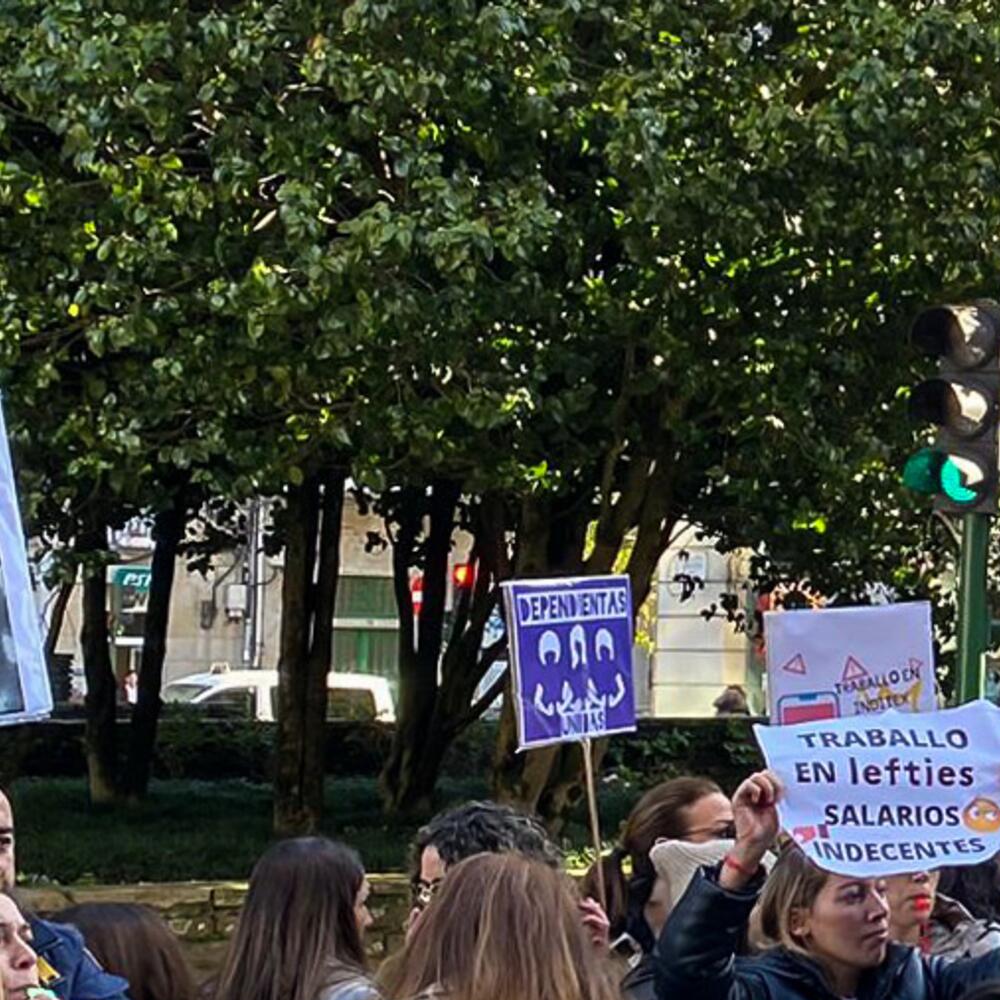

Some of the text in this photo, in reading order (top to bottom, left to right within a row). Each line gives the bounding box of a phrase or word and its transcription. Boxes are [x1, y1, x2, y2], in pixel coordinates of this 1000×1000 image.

[797, 729, 969, 749] TRABALLO
[795, 757, 974, 787] EN lefties
[824, 804, 961, 827] SALARIOS
[813, 837, 987, 863] INDECENTES
